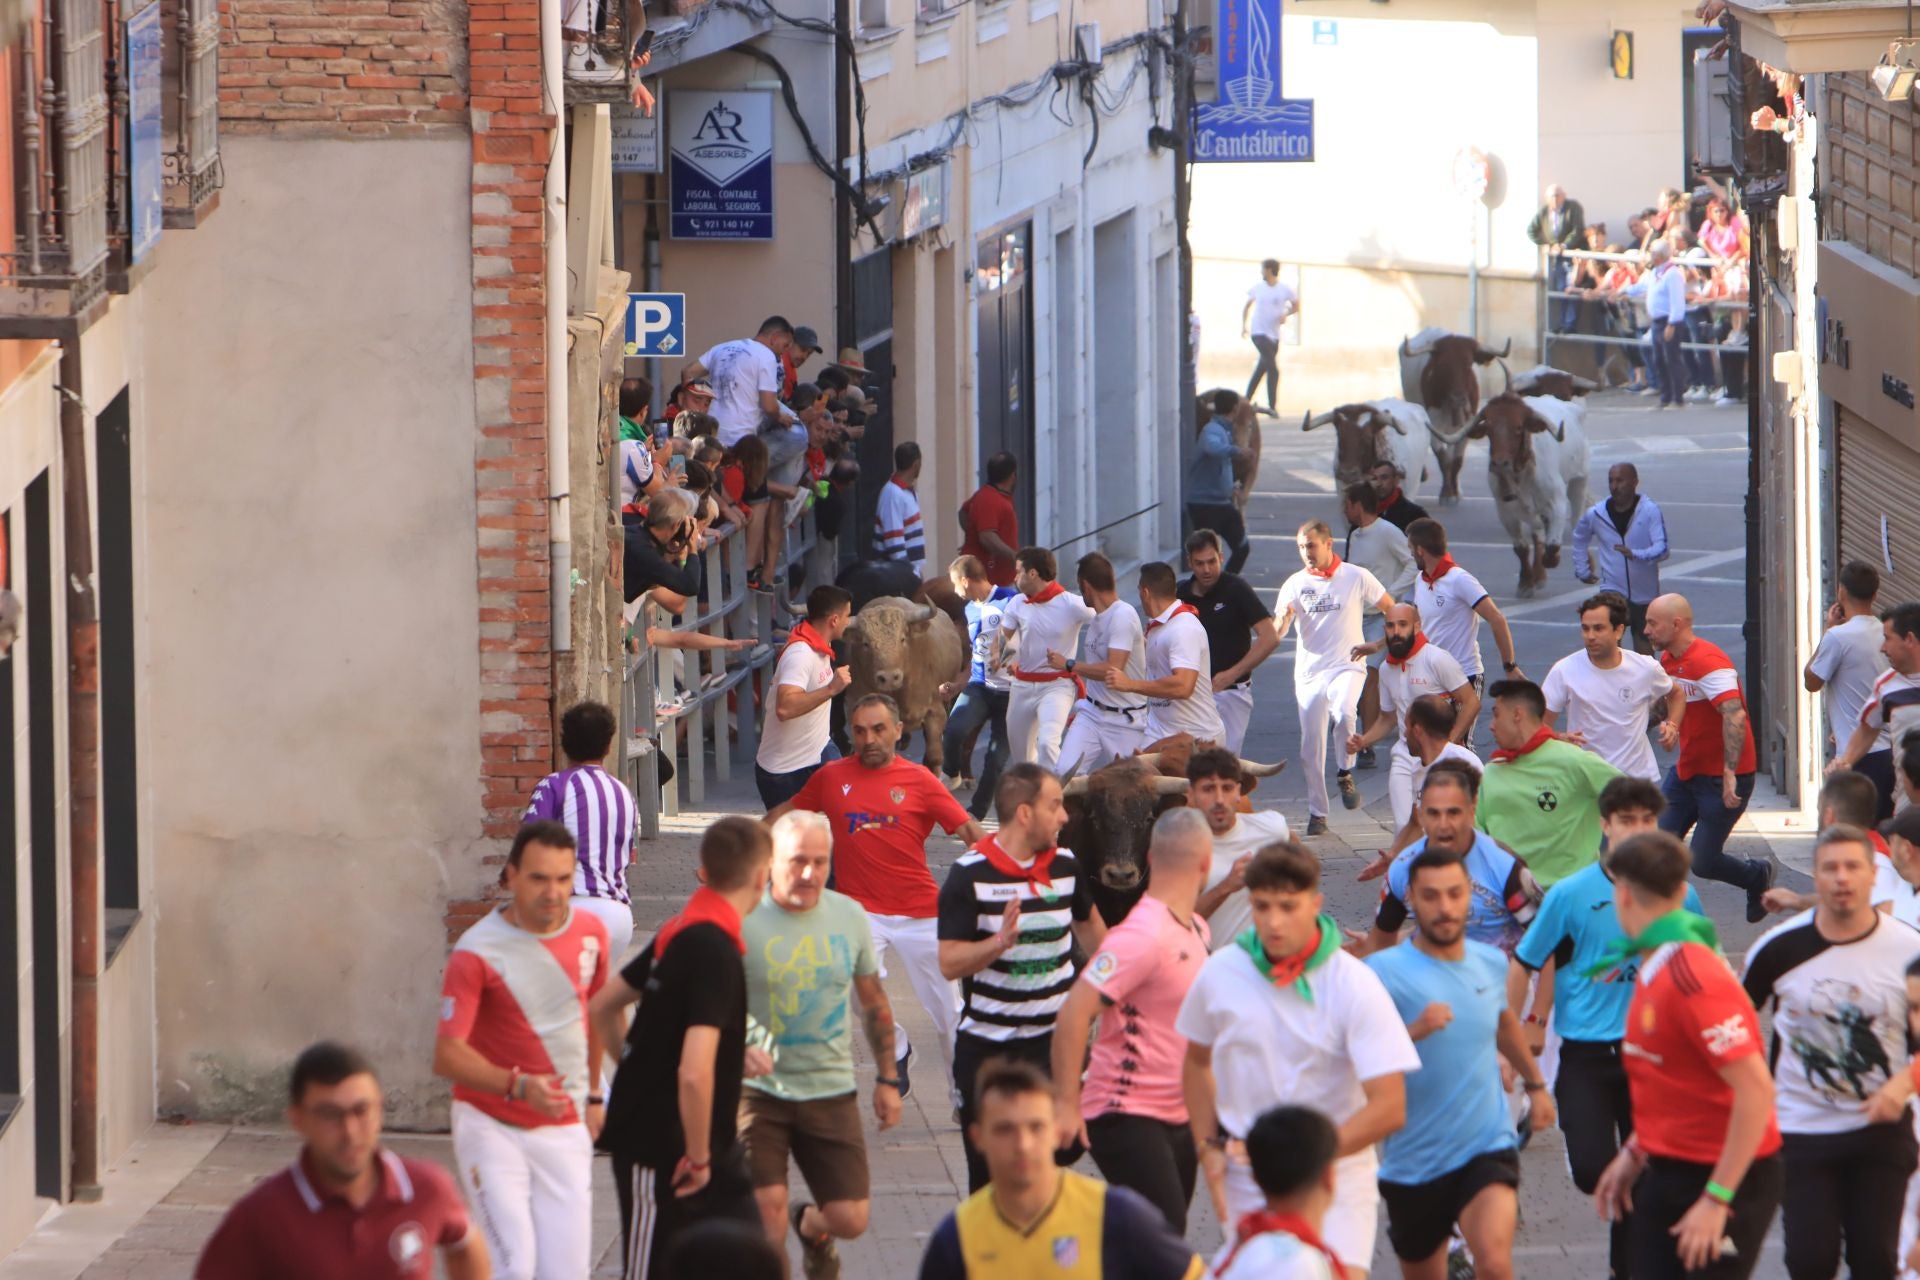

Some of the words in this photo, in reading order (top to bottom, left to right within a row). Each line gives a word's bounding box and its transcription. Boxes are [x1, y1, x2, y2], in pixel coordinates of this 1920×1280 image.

[692, 110, 749, 142] AR
[1195, 128, 1309, 157] Cantábrico
[623, 153, 638, 161] 147
[694, 150, 747, 159] ASESORES
[686, 190, 712, 199] FISCAL
[718, 190, 758, 199] CONTABLE
[683, 202, 718, 211] LABORAL
[725, 202, 761, 211] SEGUROS
[704, 220, 720, 228] 921
[722, 220, 738, 228] 140
[740, 220, 754, 228] 147
[636, 301, 672, 348] P
